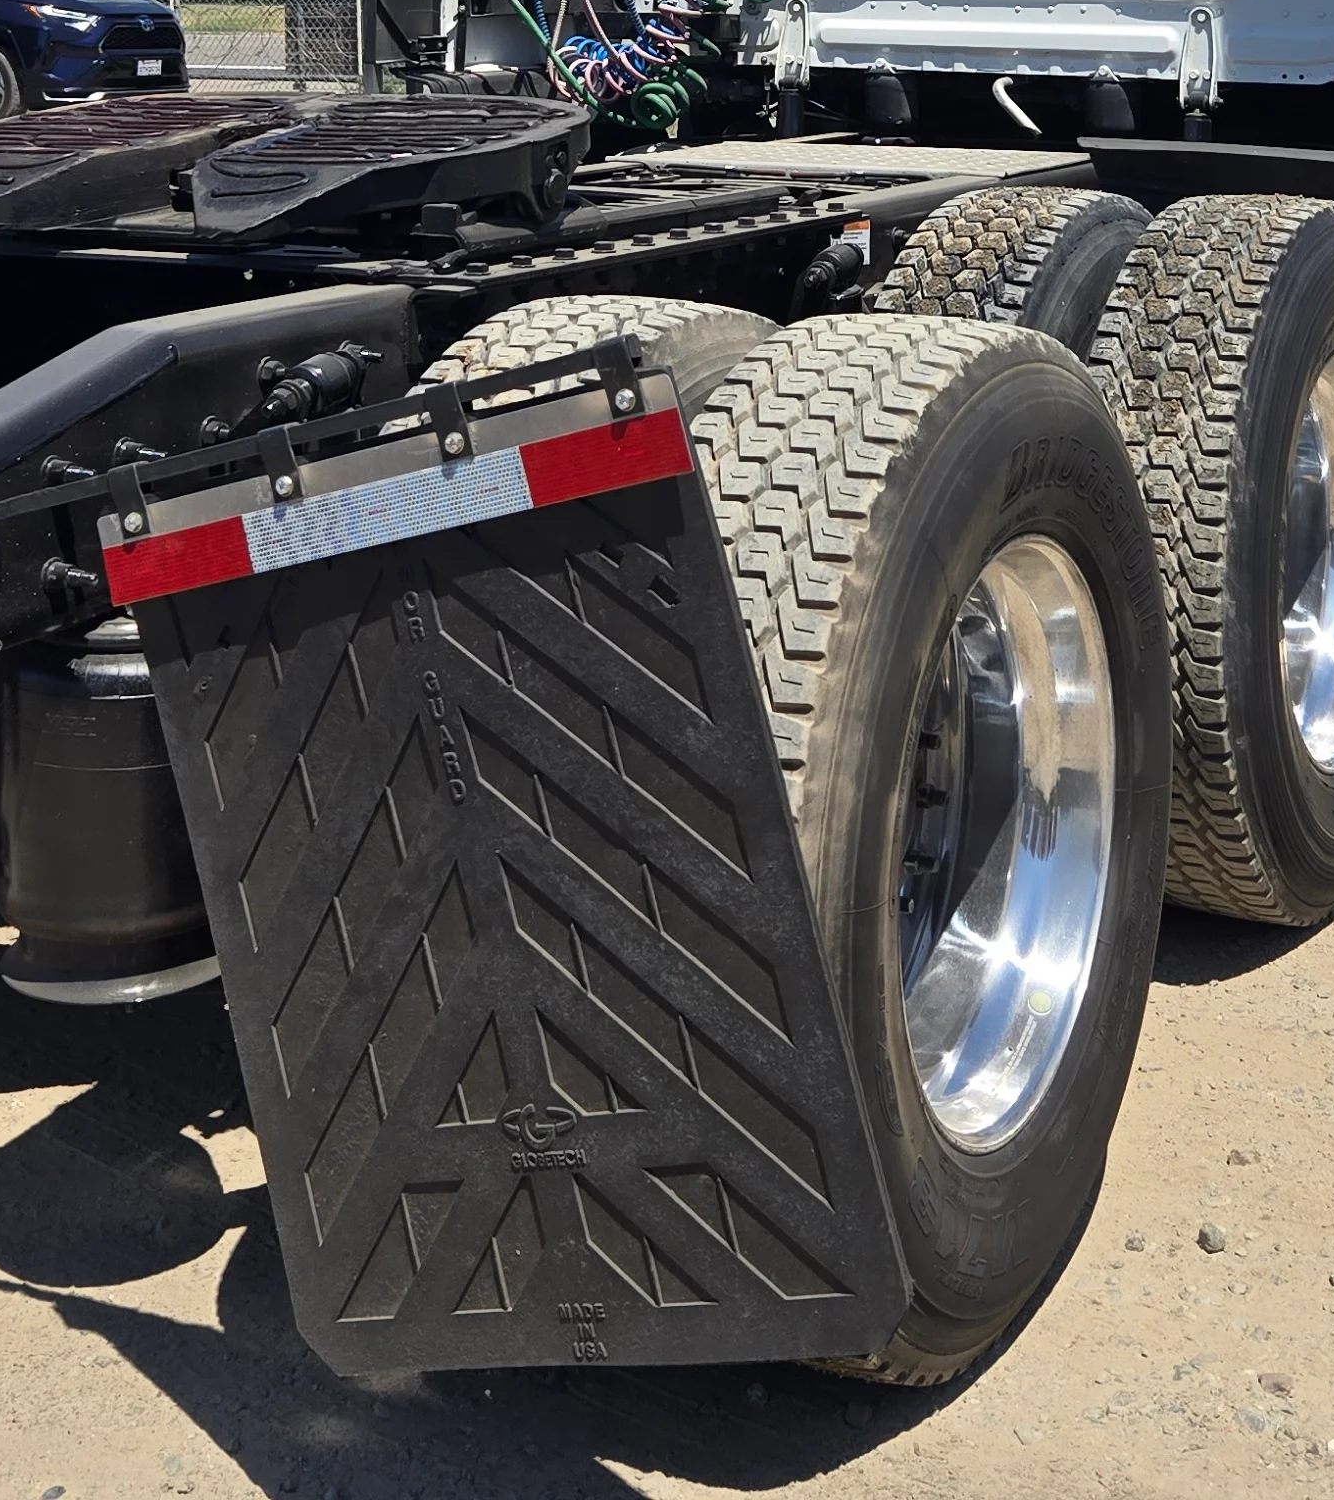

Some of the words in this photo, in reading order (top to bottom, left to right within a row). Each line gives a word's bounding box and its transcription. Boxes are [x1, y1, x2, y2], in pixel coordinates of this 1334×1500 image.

[1000, 434, 1162, 648] BRIDGESTONE
[423, 670, 467, 803] GUARD
[511, 1148, 588, 1169] GLOBETECH
[557, 1302, 607, 1321] MADE
[577, 1322, 597, 1340] IN
[572, 1341, 609, 1362] USA
